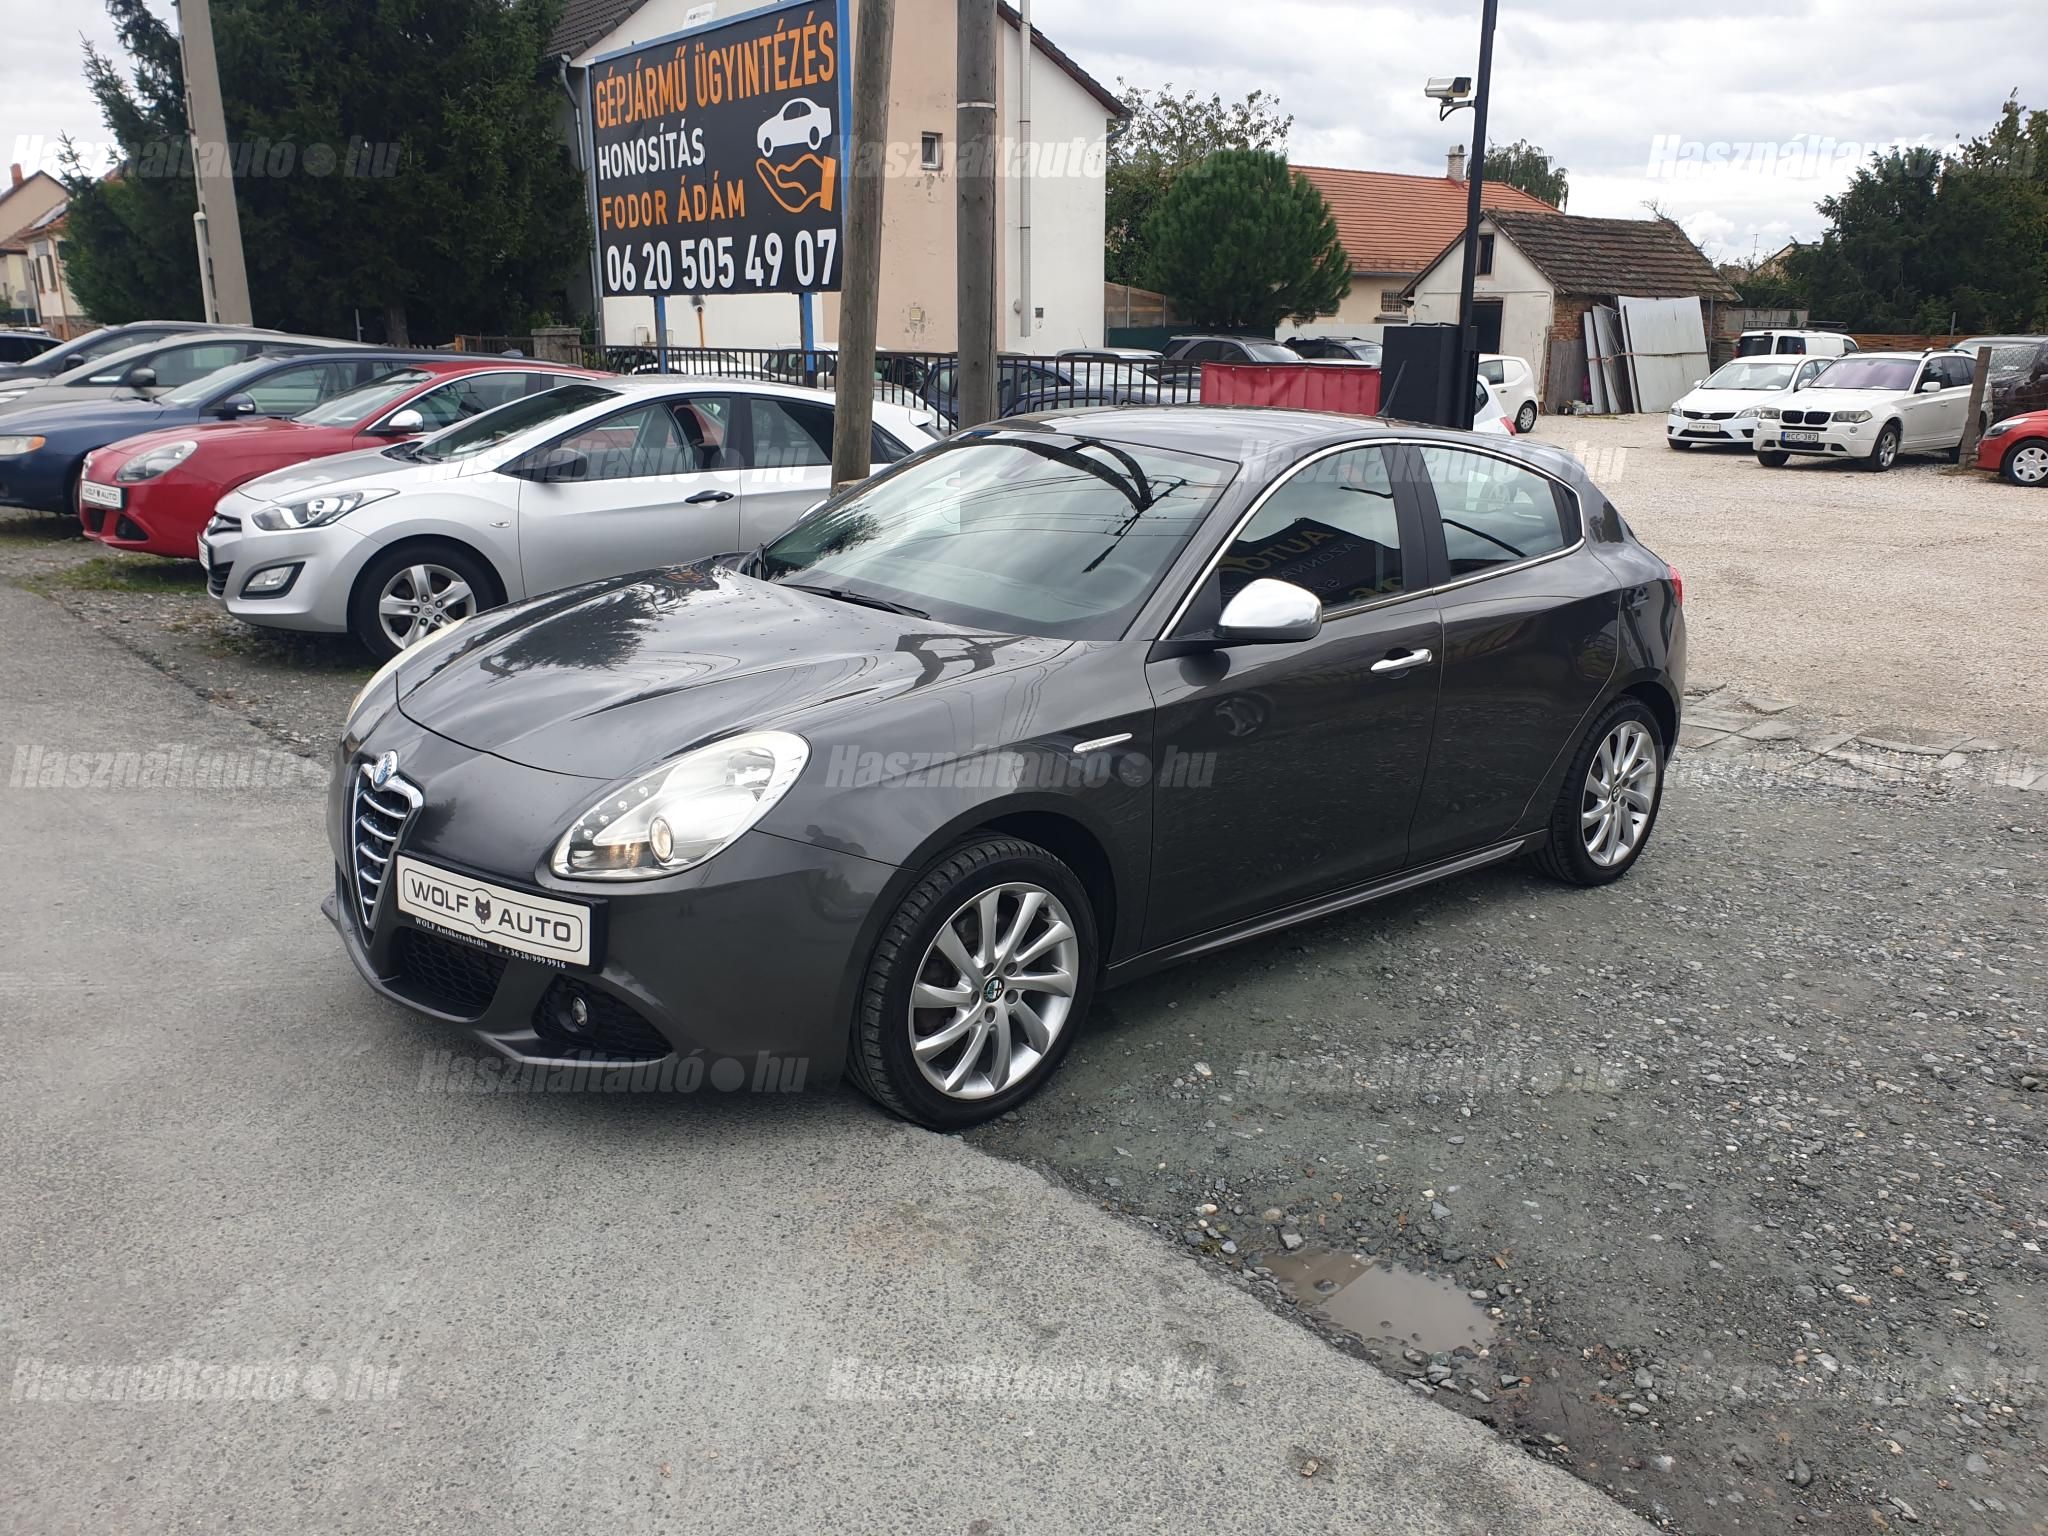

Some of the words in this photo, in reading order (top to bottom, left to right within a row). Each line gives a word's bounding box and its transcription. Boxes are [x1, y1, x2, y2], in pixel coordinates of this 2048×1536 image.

[595, 44, 687, 129] GÉPJÁRMŰ
[694, 10, 835, 108] ÜGYINTÉZÉS
[598, 118, 706, 180] HONOSÍTÁS
[601, 190, 668, 231] FODOR
[677, 170, 746, 224] ÁDÁM
[606, 245, 637, 292] 06
[642, 241, 673, 290] 20
[680, 236, 735, 289] 505
[745, 232, 783, 287] 49
[795, 229, 837, 287] 07
[411, 878, 469, 913] WOLF
[498, 908, 571, 943] AUTO
[415, 917, 436, 930] WOLF
